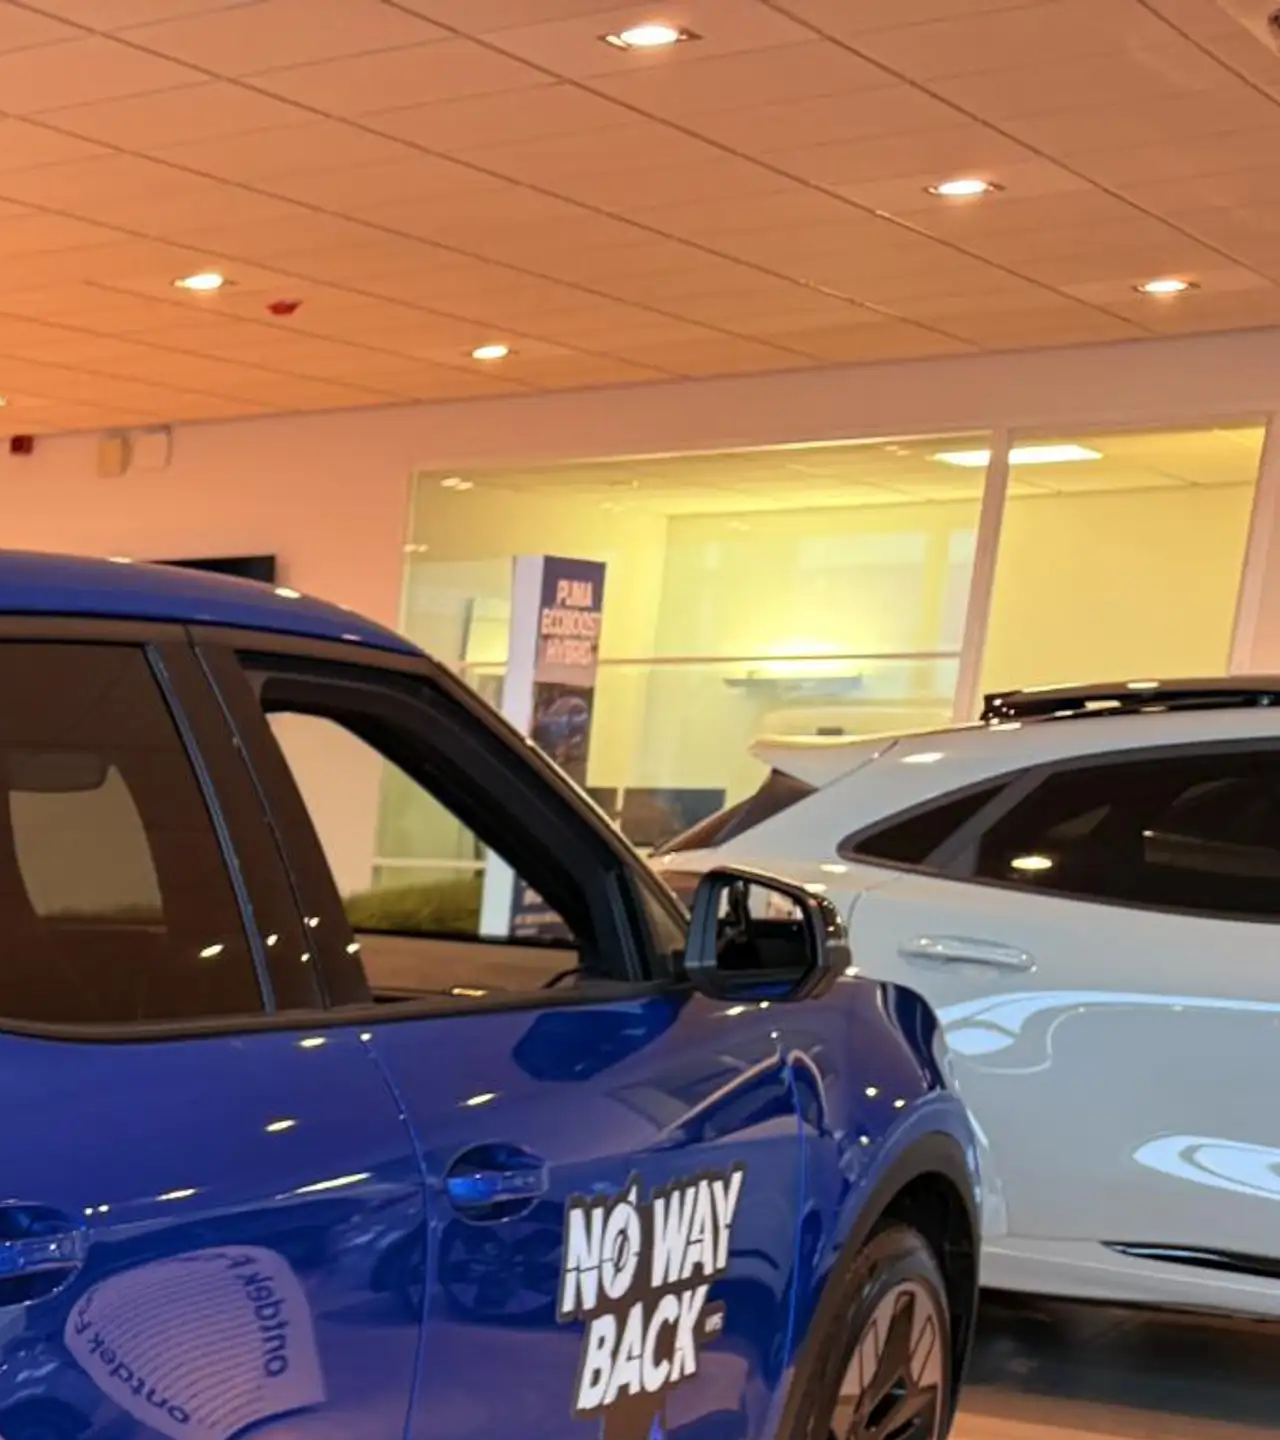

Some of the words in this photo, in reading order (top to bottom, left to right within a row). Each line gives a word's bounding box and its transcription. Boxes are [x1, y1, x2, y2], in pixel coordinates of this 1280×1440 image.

[562, 1184, 641, 1313] NO
[651, 1170, 744, 1288] WAY
[576, 1284, 710, 1411] BACK
